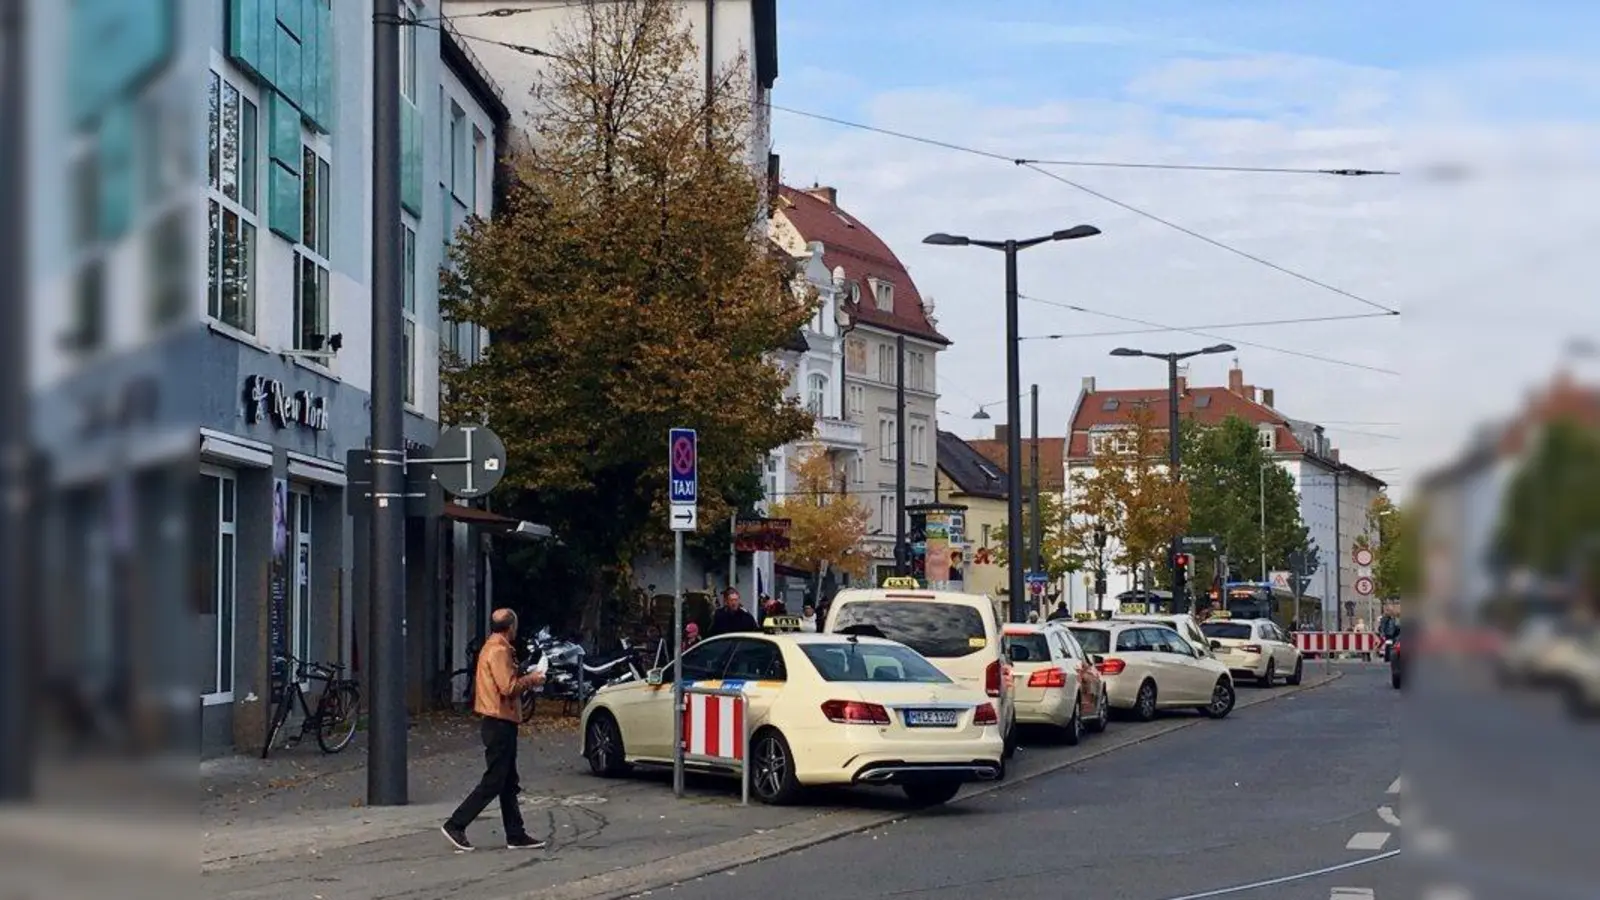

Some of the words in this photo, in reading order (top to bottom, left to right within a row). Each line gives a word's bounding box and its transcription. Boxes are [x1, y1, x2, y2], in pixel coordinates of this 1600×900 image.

[271, 379, 301, 428] New
[303, 390, 329, 430] York
[673, 480, 695, 496] TAXI
[887, 578, 911, 588] TAXI
[1362, 582, 1369, 592] 5
[774, 617, 799, 627] TAXI
